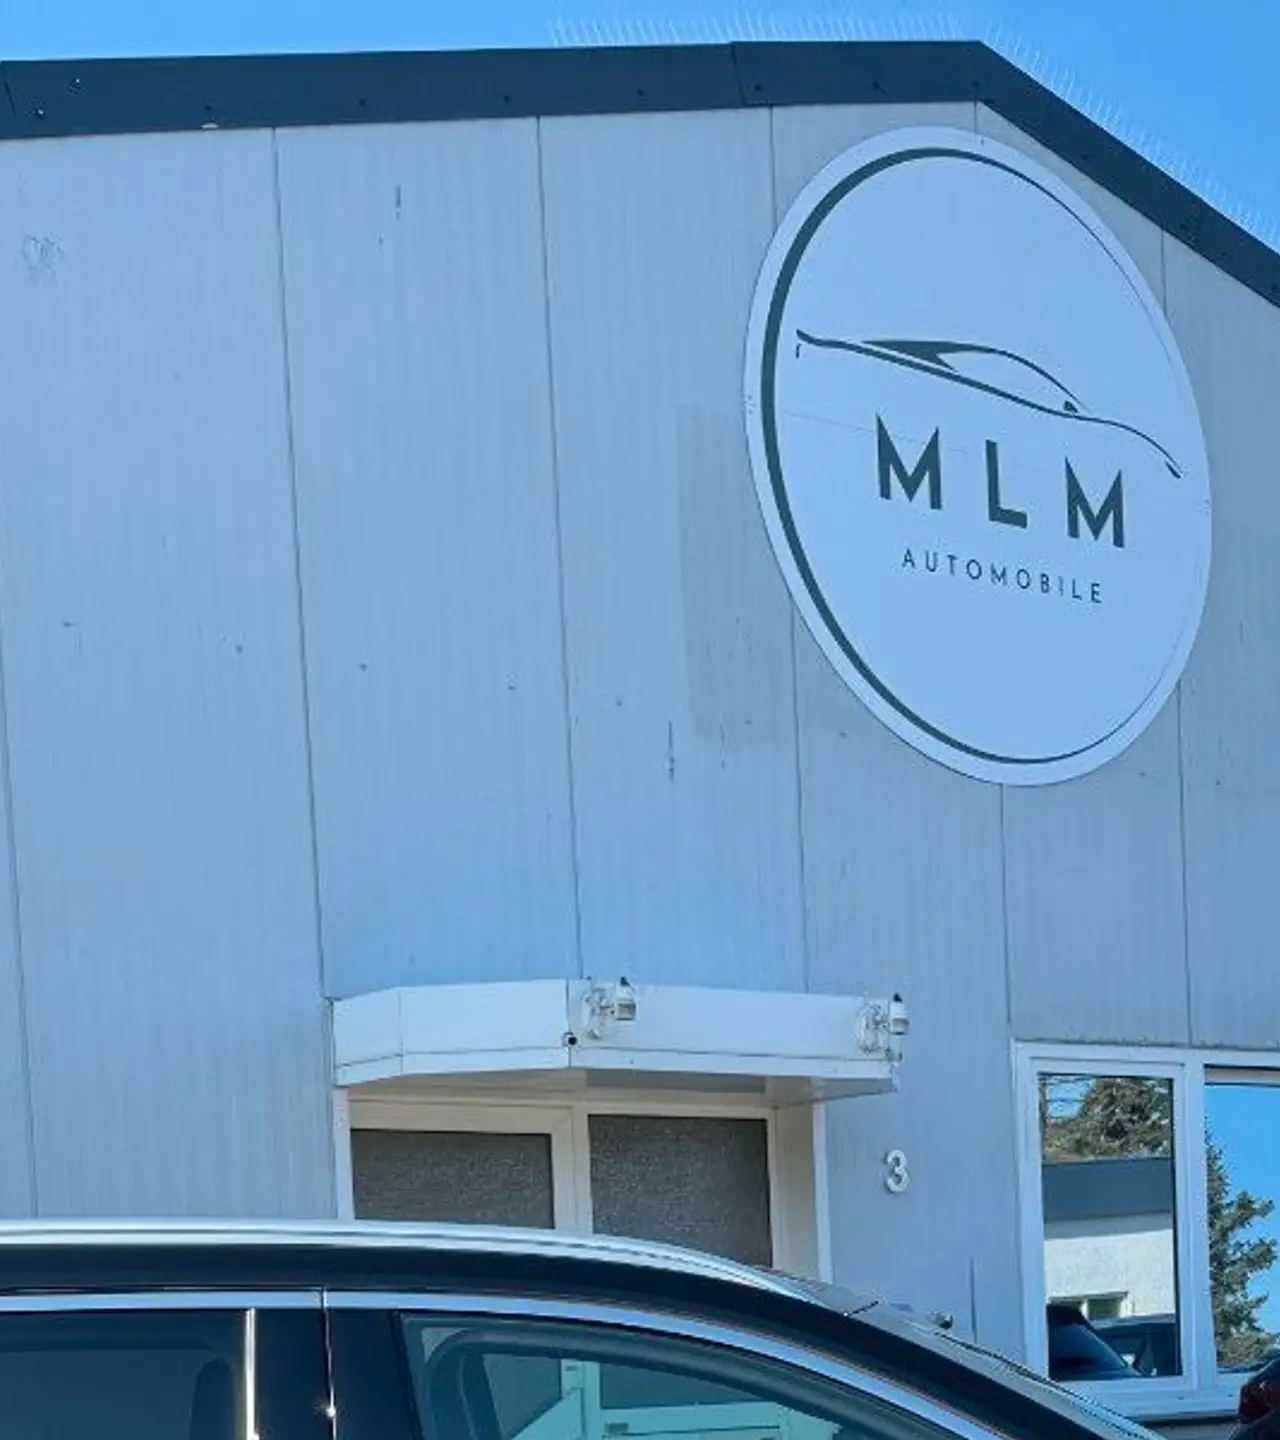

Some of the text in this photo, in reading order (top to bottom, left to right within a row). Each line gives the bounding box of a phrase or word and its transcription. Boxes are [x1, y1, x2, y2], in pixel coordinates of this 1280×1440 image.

[876, 411, 1125, 549] MLM
[901, 547, 1102, 604] AUTOMOBILE
[885, 1148, 910, 1193] 3
